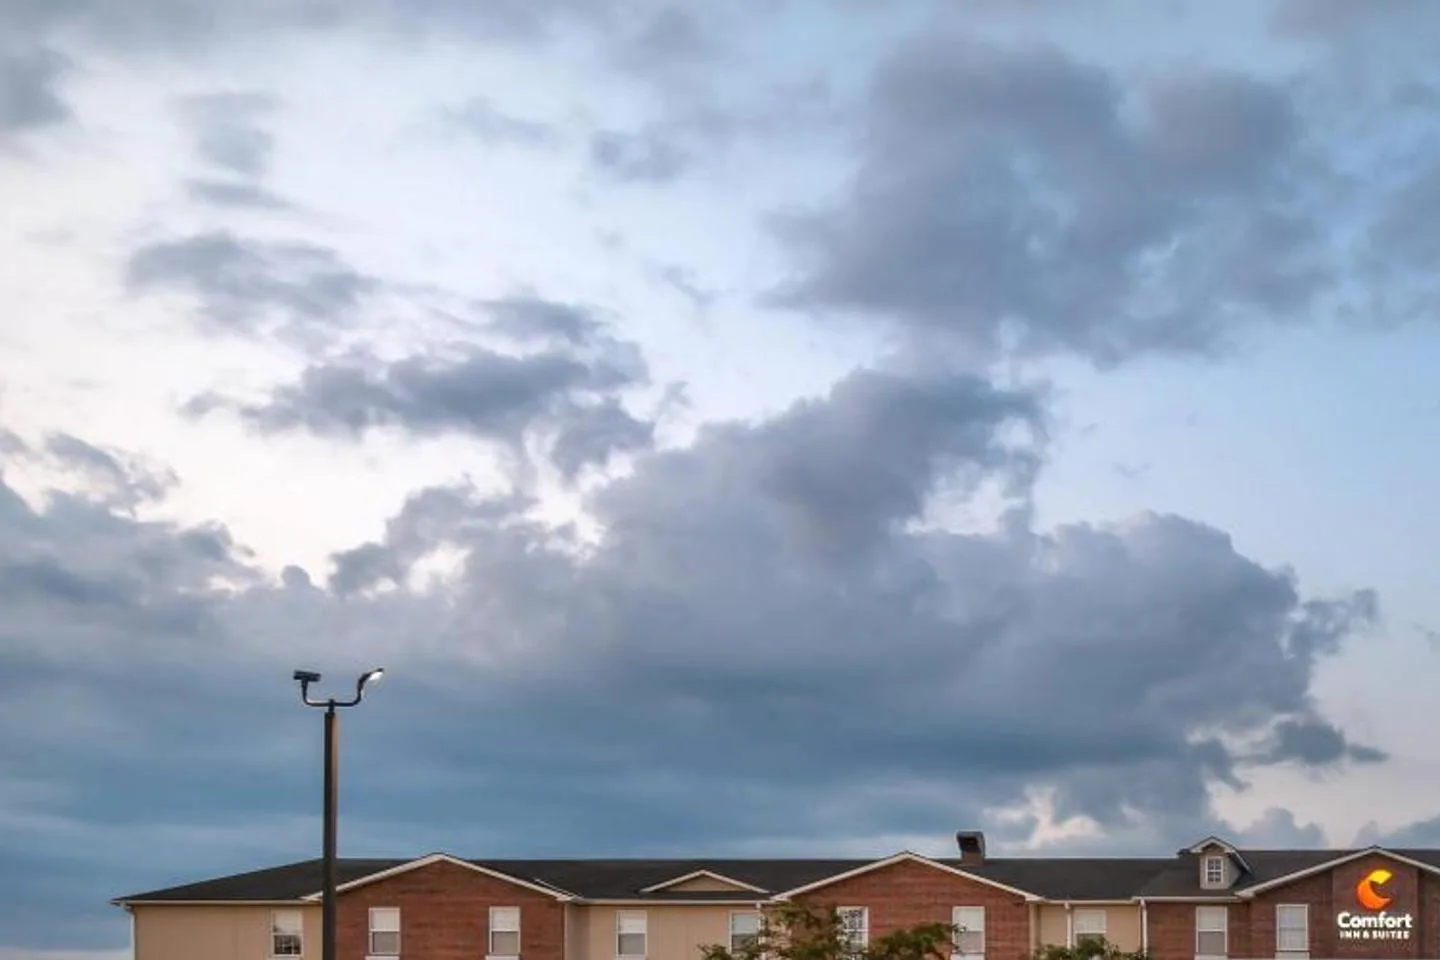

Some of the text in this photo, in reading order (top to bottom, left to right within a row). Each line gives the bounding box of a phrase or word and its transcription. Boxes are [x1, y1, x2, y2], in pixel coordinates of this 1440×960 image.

[1338, 911, 1413, 928] Comfort
[1340, 930, 1410, 939] INN & SUITES
